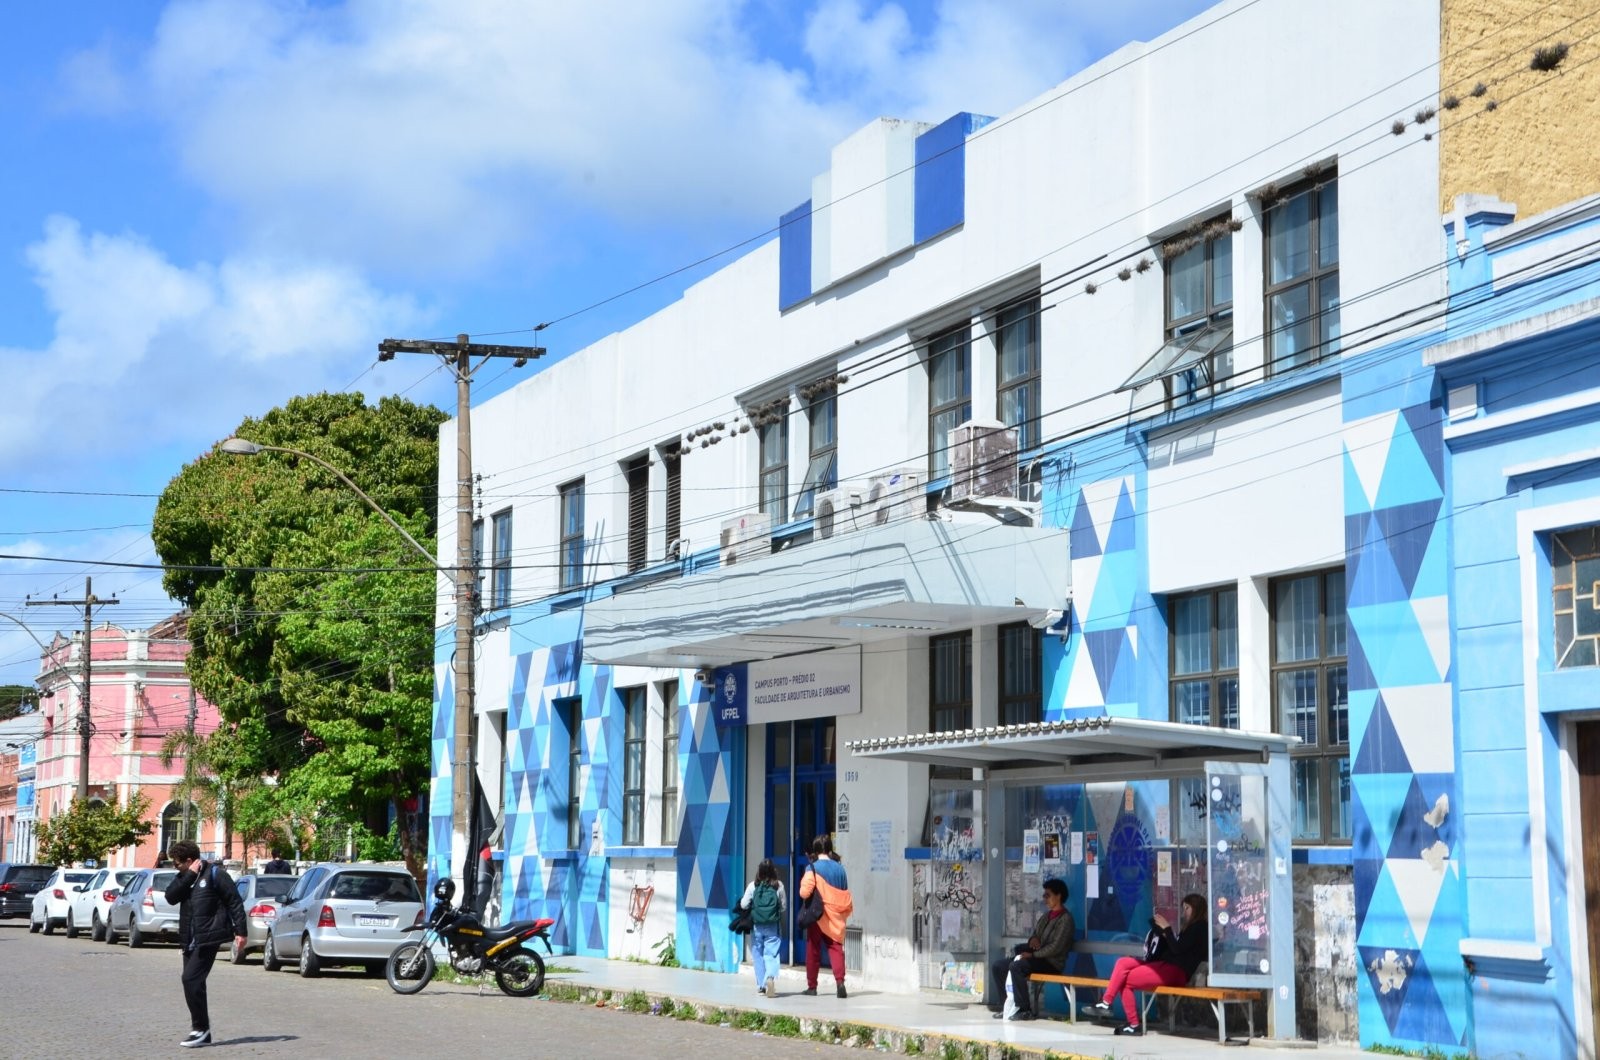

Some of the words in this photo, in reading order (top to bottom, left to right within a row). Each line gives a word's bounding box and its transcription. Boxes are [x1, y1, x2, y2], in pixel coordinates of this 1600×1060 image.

[754, 679, 773, 689] CAMPUS
[773, 676, 788, 687] PORTO
[792, 672, 809, 685] PRÉDIO
[754, 693, 779, 704] FACULDADE
[780, 691, 786, 702] DE
[787, 688, 818, 702] ARQUITETURA
[823, 684, 851, 697] URBANISMO
[721, 708, 740, 720] UFPEL
